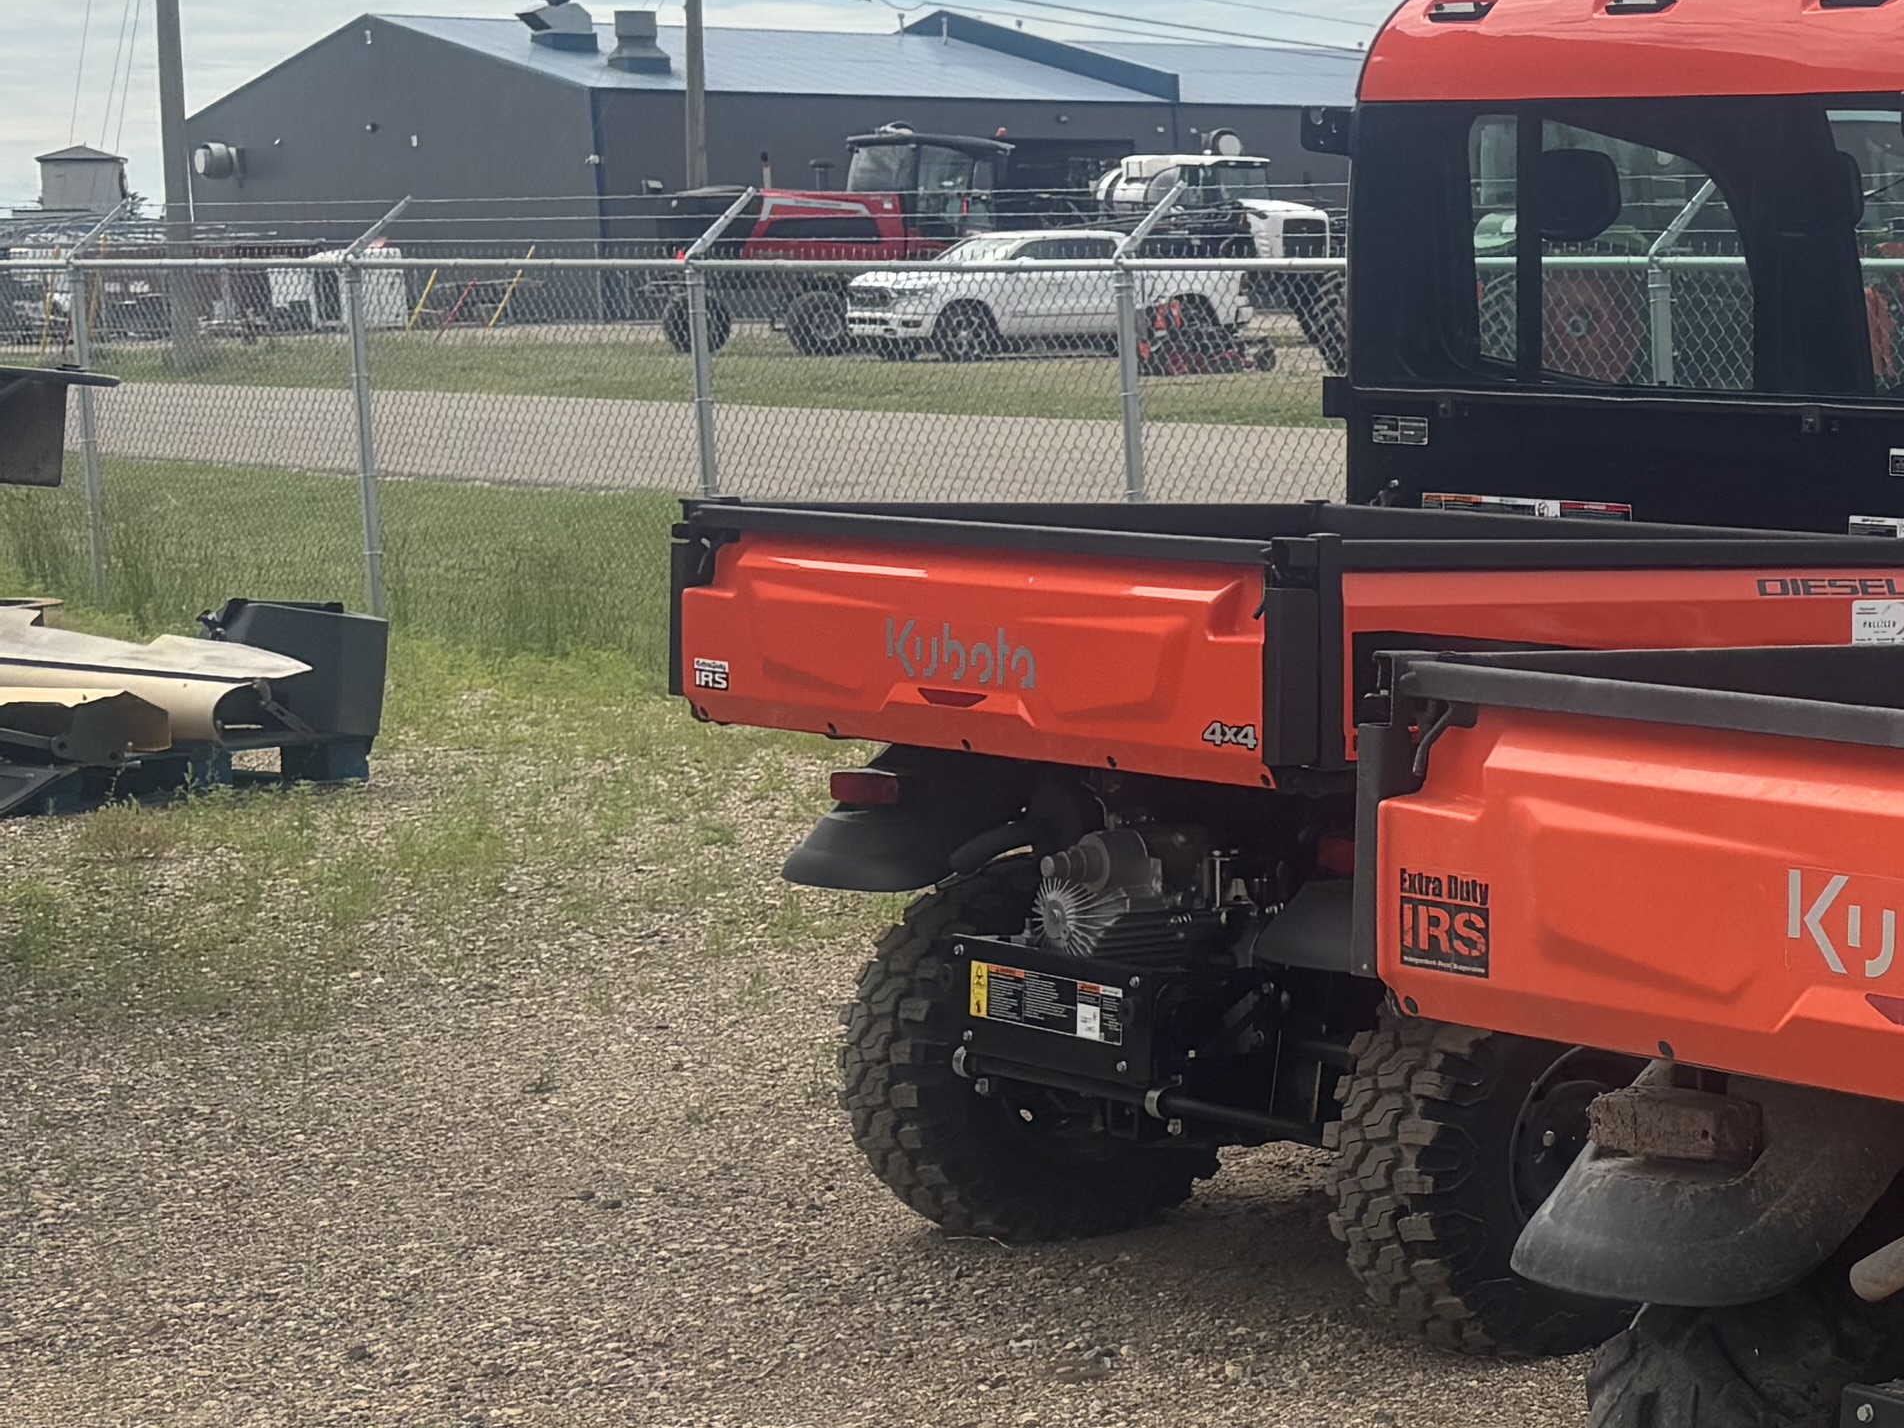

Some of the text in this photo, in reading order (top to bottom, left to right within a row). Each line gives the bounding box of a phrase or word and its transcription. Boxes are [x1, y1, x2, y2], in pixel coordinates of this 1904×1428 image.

[886, 616, 1036, 689] Kubota
[695, 670, 728, 689] IRS
[1203, 721, 1258, 750] 4x4
[1400, 868, 1490, 906] Extra Duty
[1403, 904, 1487, 957] IRS
